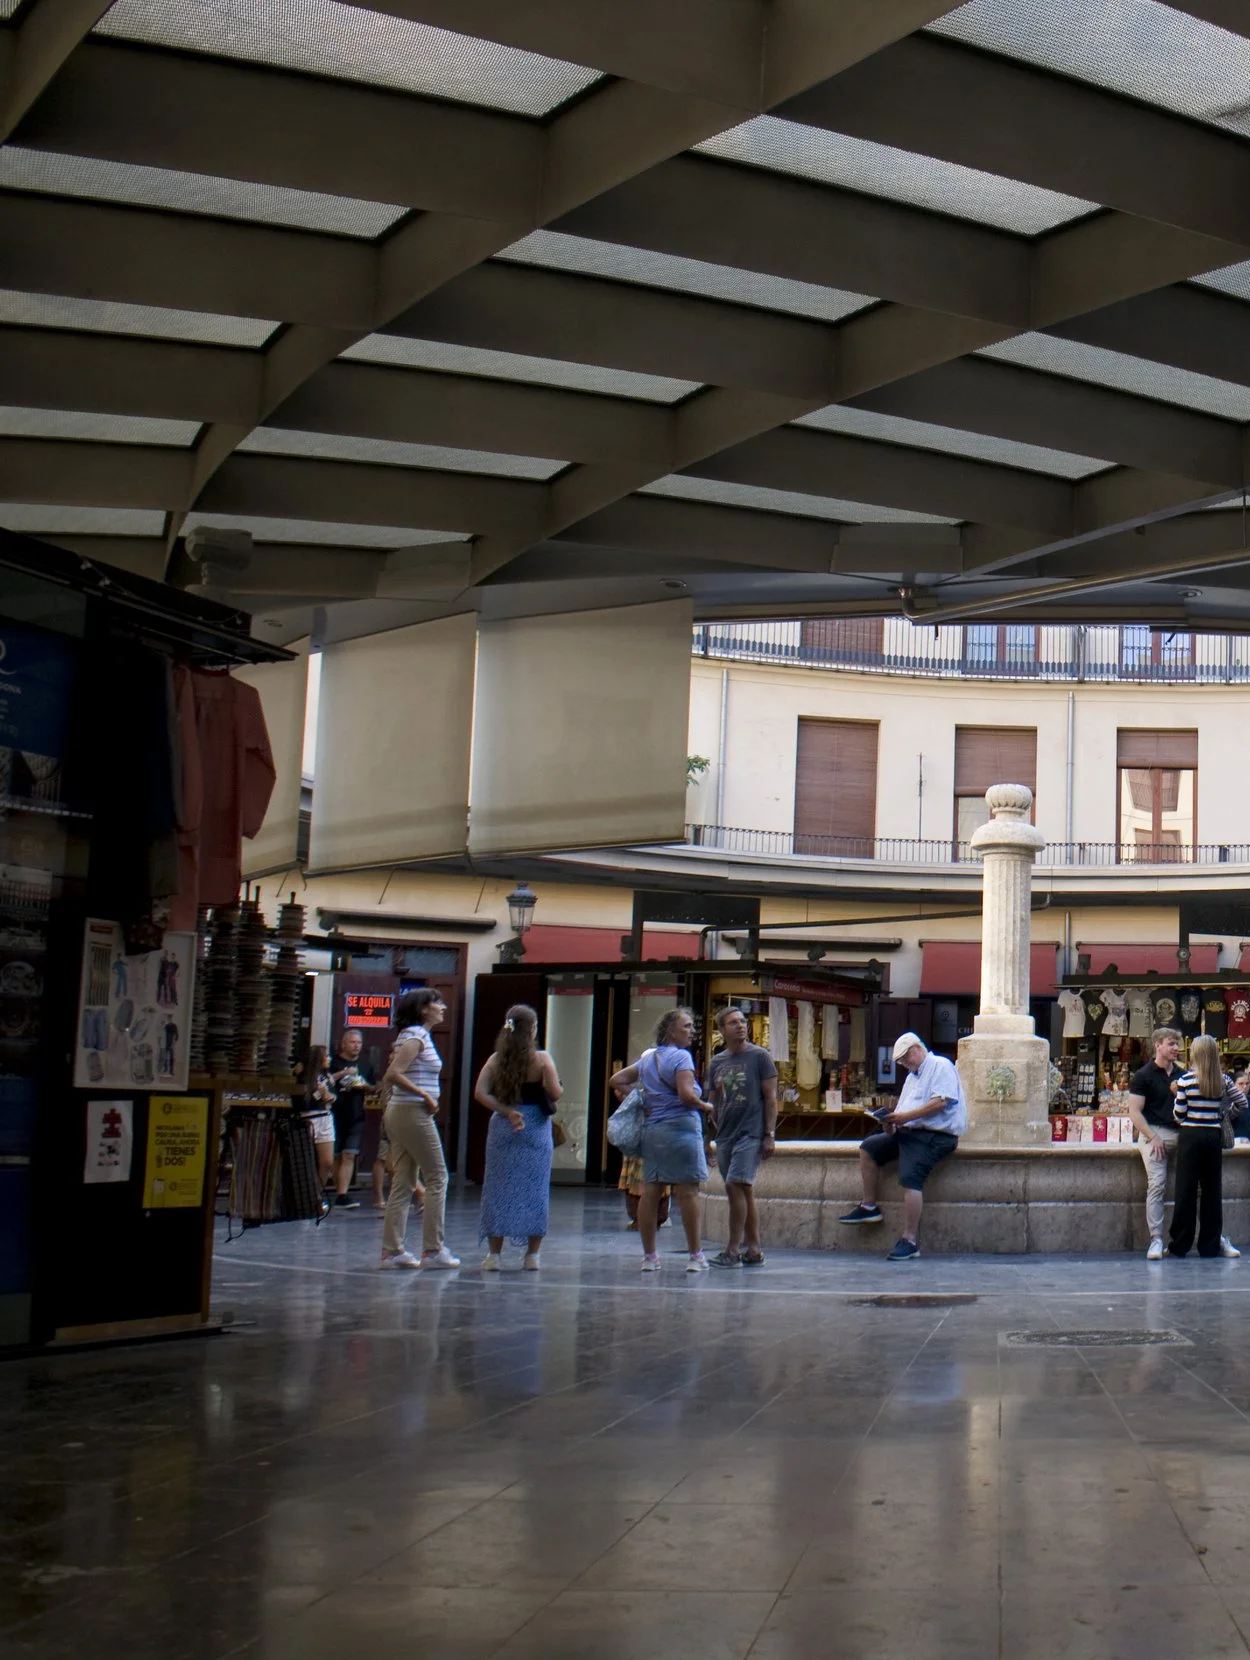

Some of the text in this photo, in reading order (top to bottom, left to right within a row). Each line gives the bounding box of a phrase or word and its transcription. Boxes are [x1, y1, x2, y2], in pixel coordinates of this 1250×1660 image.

[347, 996, 391, 1009] SE ALQUILA
[165, 1147, 196, 1156] TIENES
